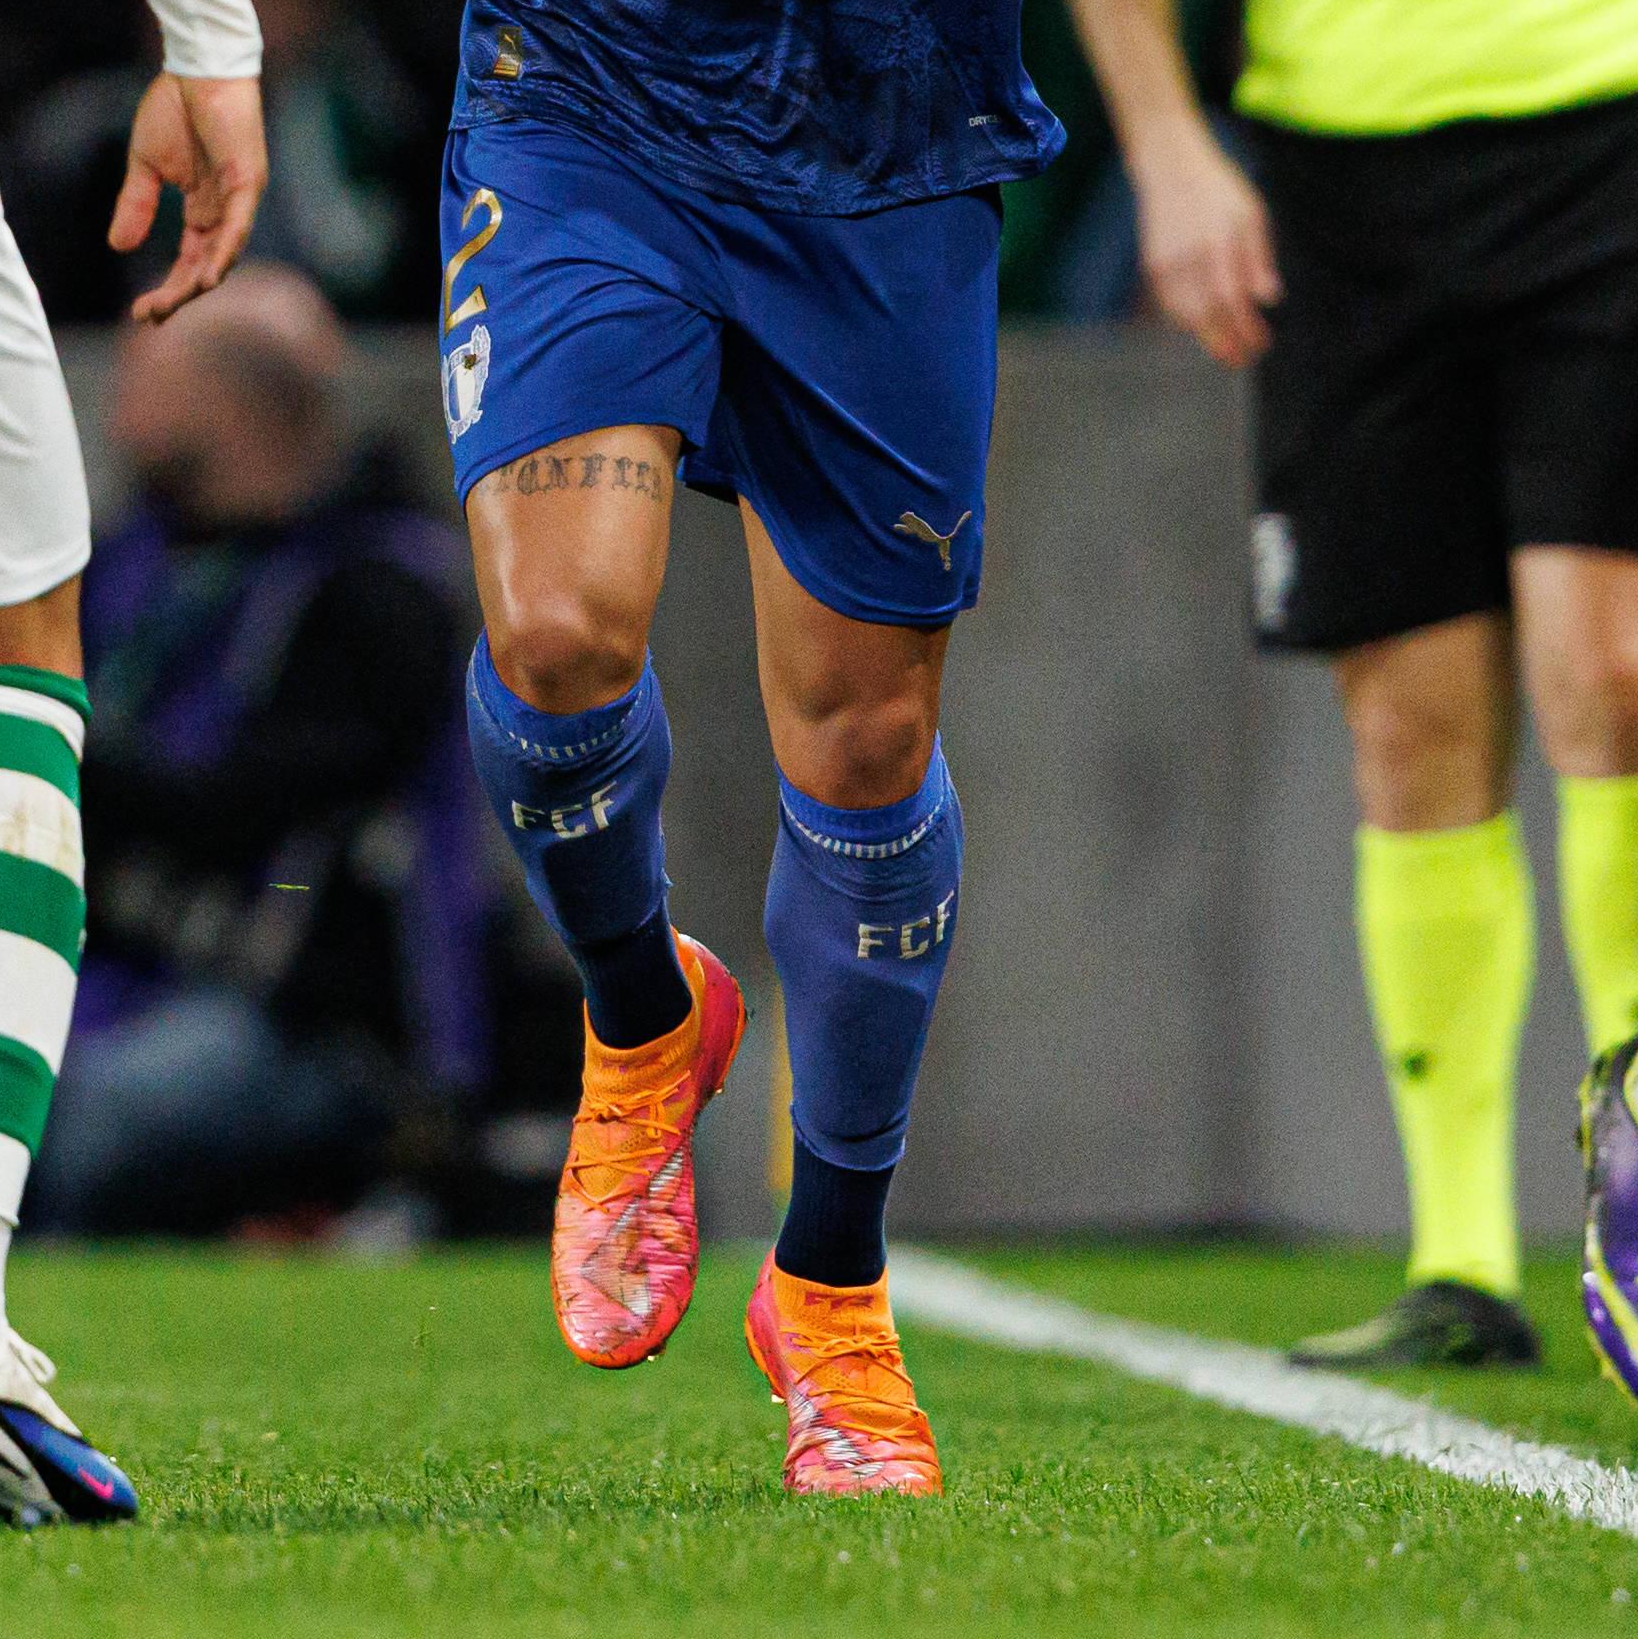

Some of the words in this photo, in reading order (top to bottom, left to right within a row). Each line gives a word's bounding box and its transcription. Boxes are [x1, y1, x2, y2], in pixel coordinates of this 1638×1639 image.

[443, 187, 503, 338] 2
[511, 780, 618, 839] FCF
[857, 889, 954, 960] FCF
